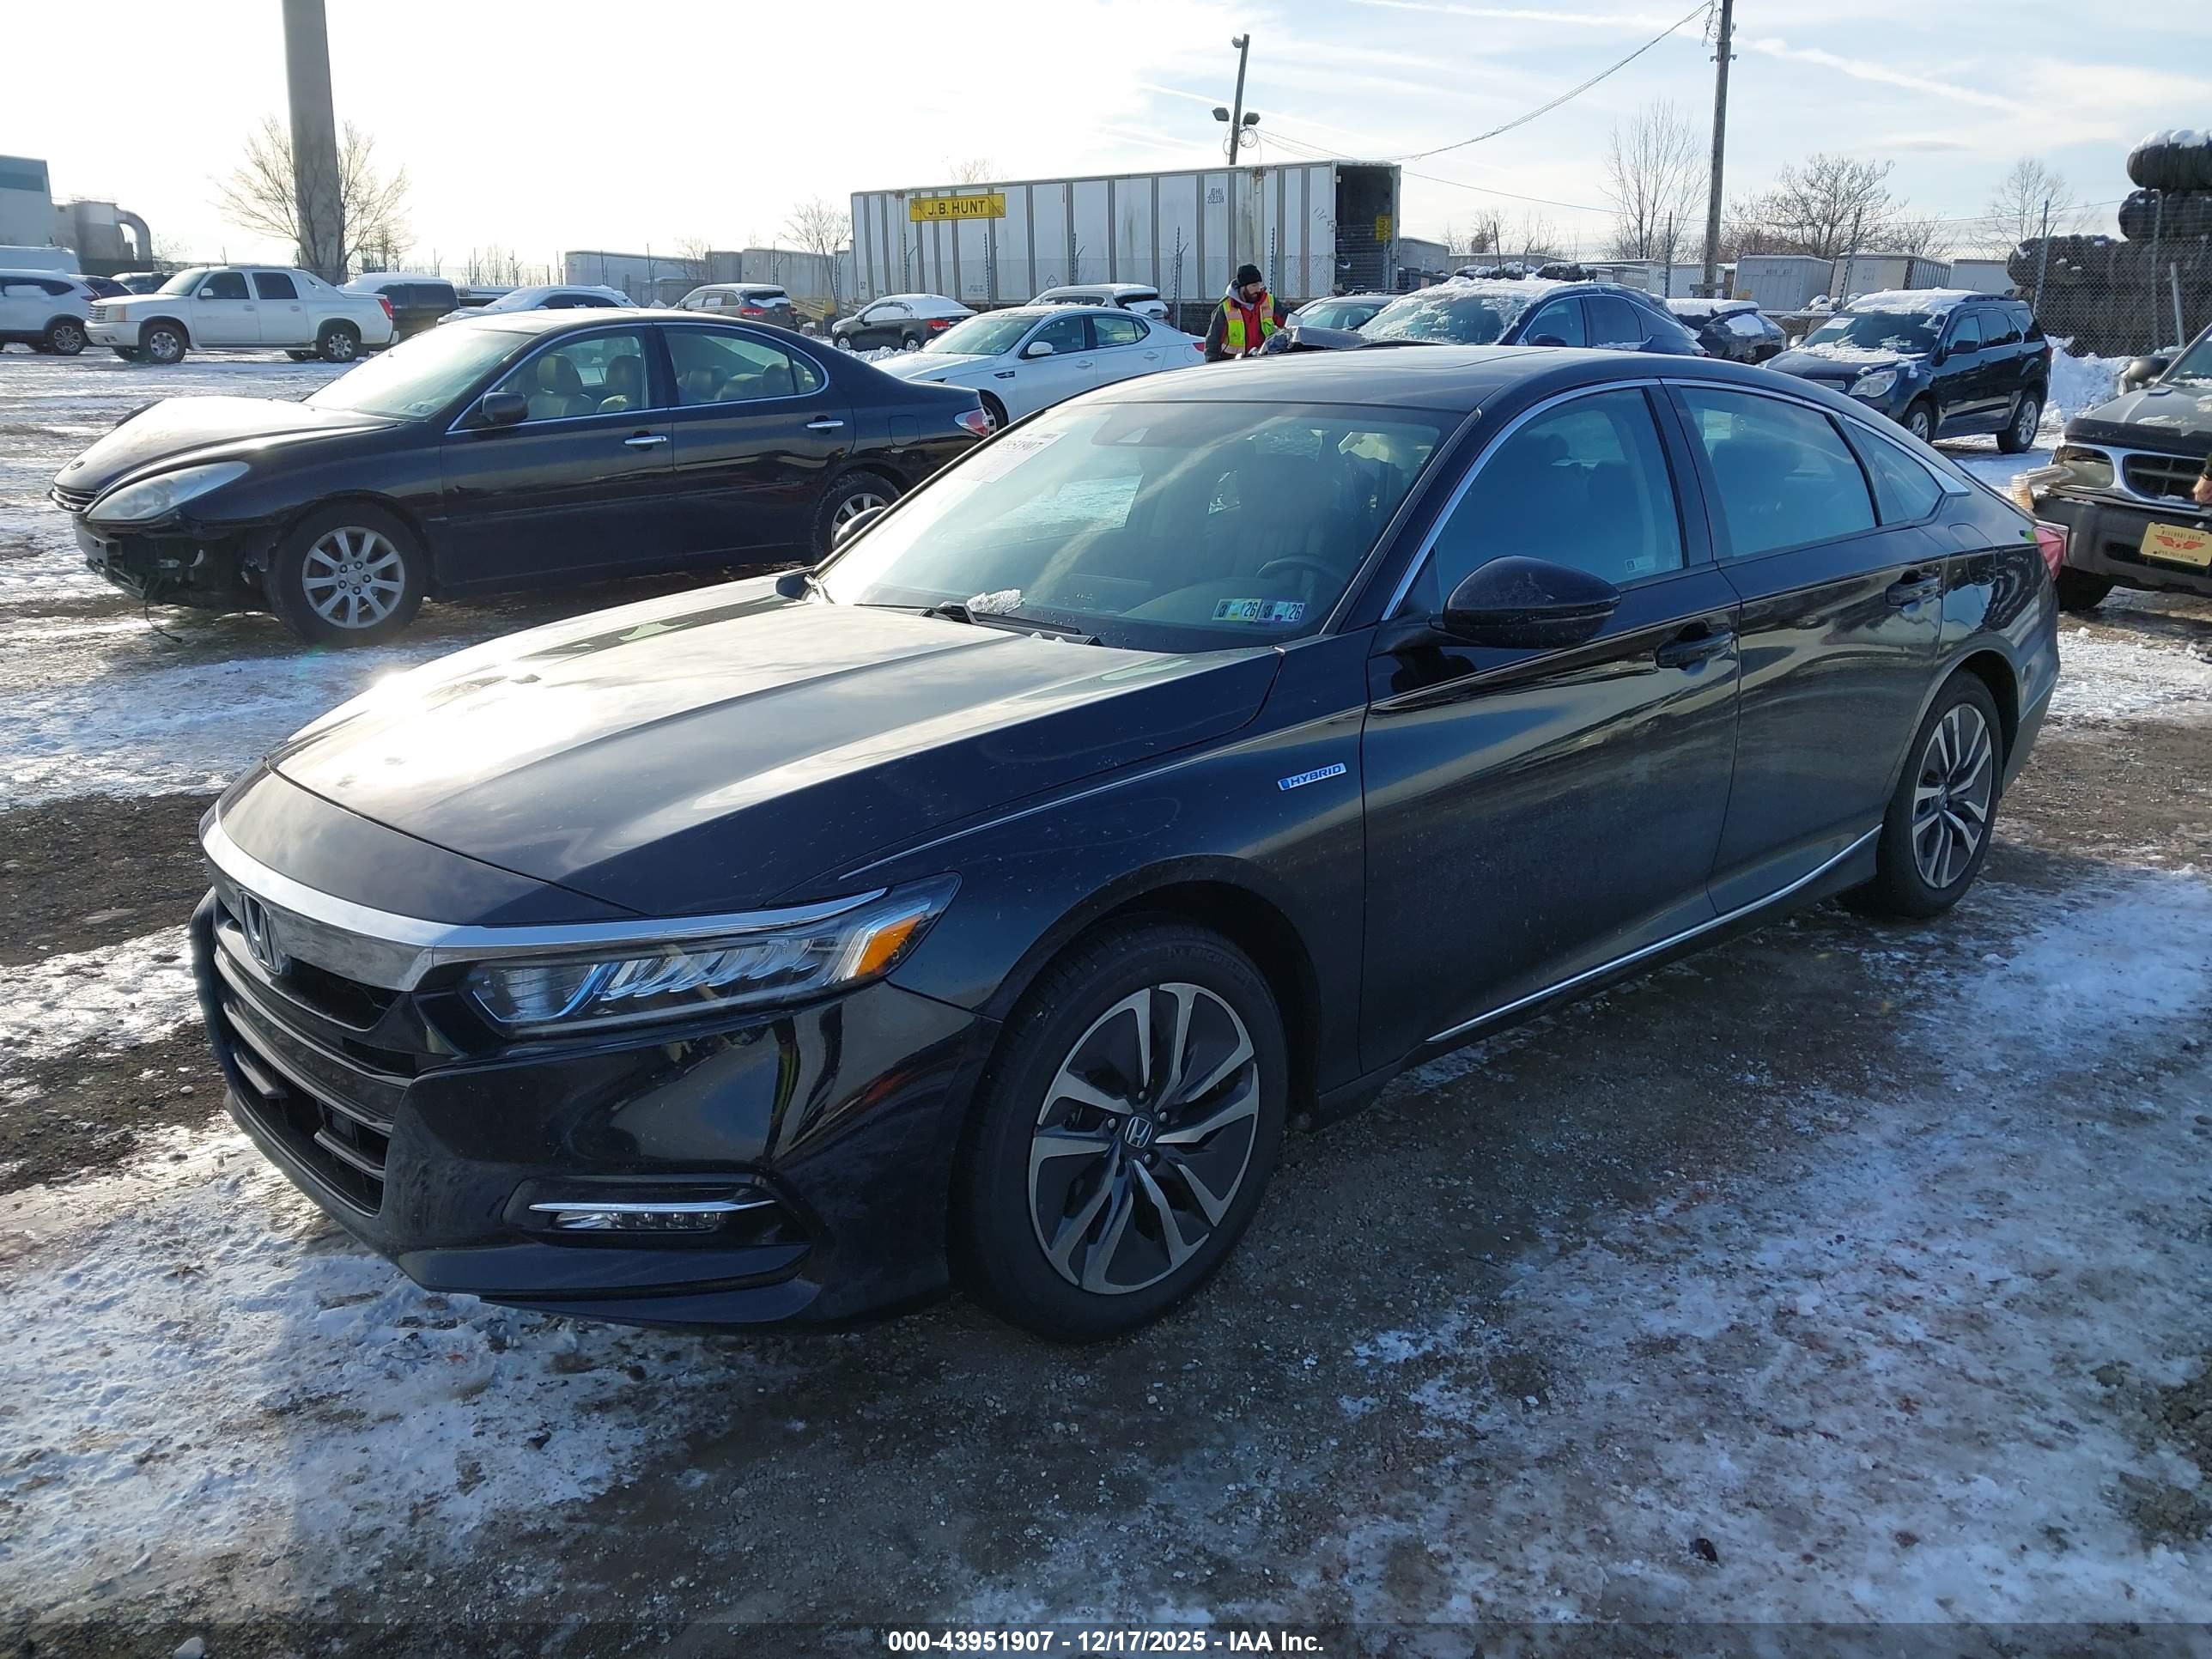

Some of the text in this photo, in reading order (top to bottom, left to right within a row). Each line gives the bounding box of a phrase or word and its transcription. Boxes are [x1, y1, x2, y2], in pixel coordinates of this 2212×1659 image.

[951, 199, 985, 215] HUNT
[1218, 601, 1258, 618] 3 26
[1288, 604, 1304, 620] 26
[1290, 765, 1342, 786] HYBRID
